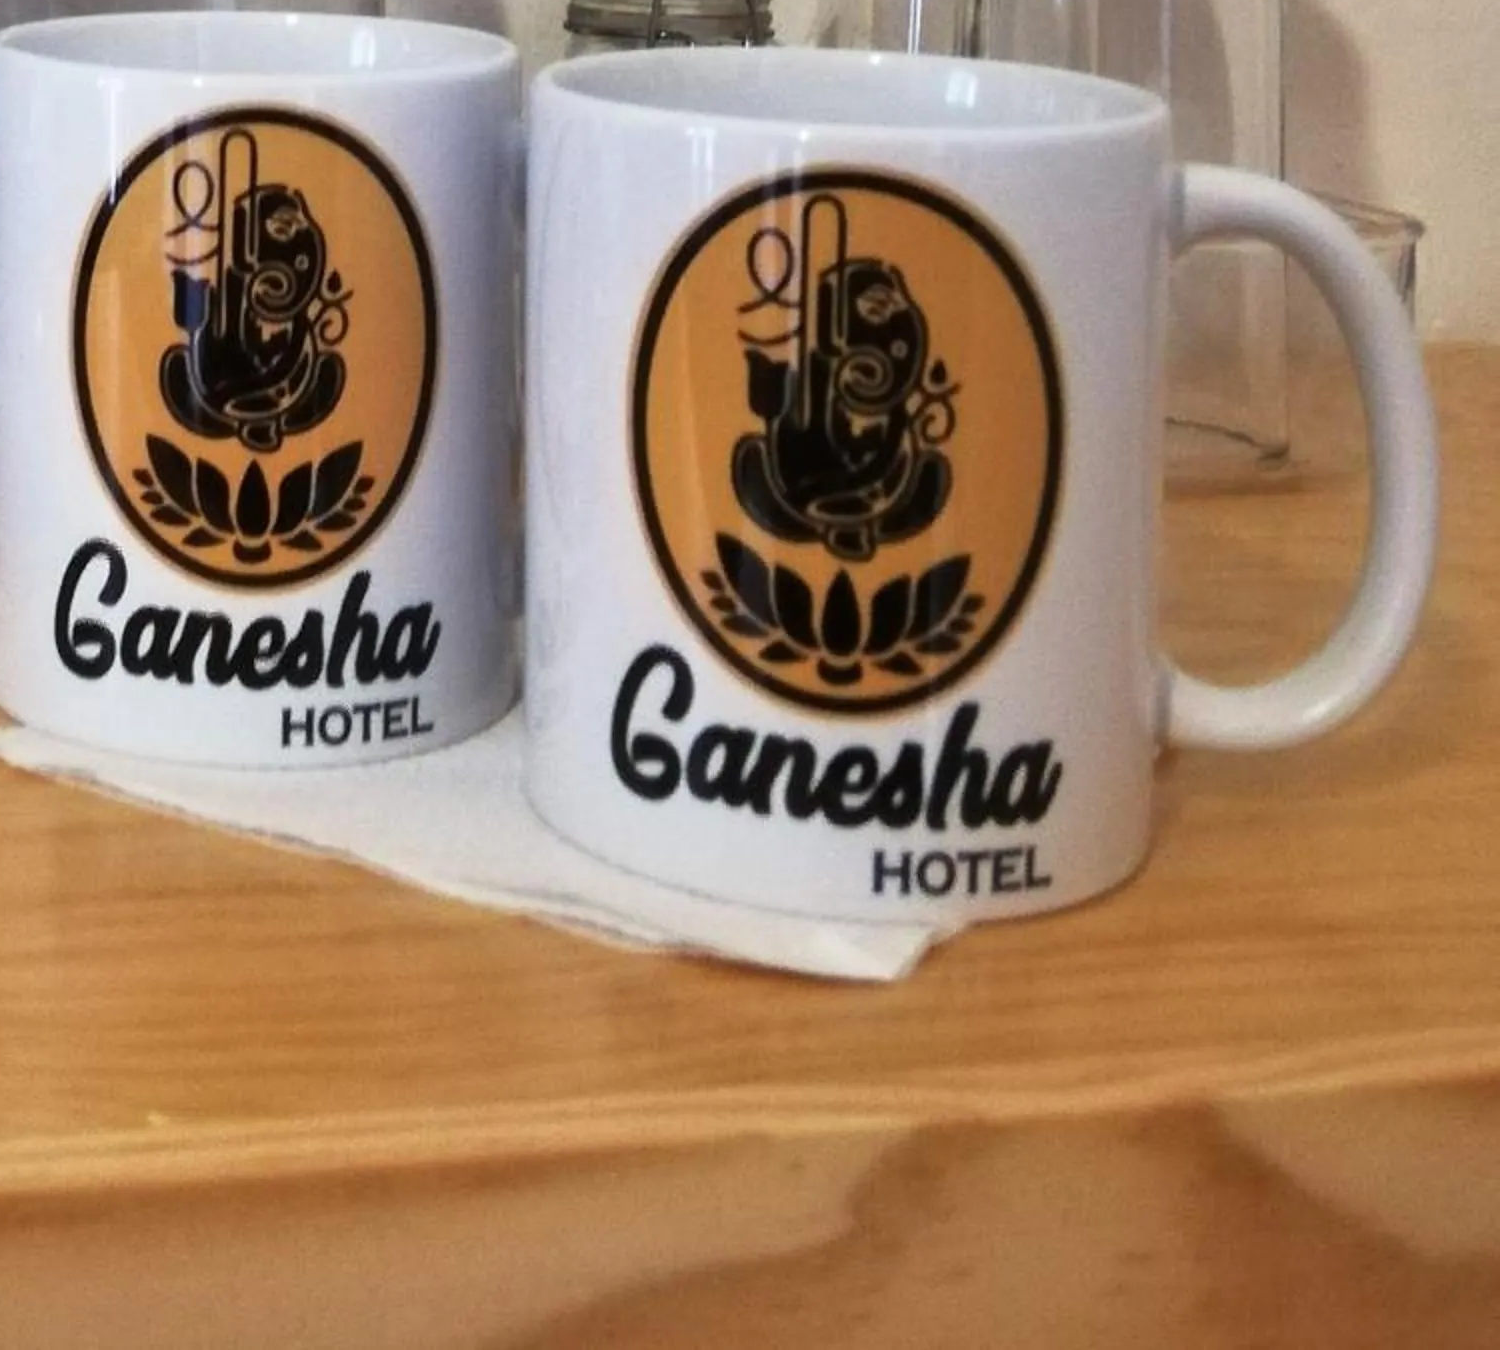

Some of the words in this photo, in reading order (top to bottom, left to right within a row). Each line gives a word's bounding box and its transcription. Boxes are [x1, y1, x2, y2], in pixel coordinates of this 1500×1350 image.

[54, 537, 442, 690] Ganesha
[281, 695, 434, 748] HOTEL
[610, 644, 1062, 831] Ganesha
[871, 845, 1051, 897] HOTEL
